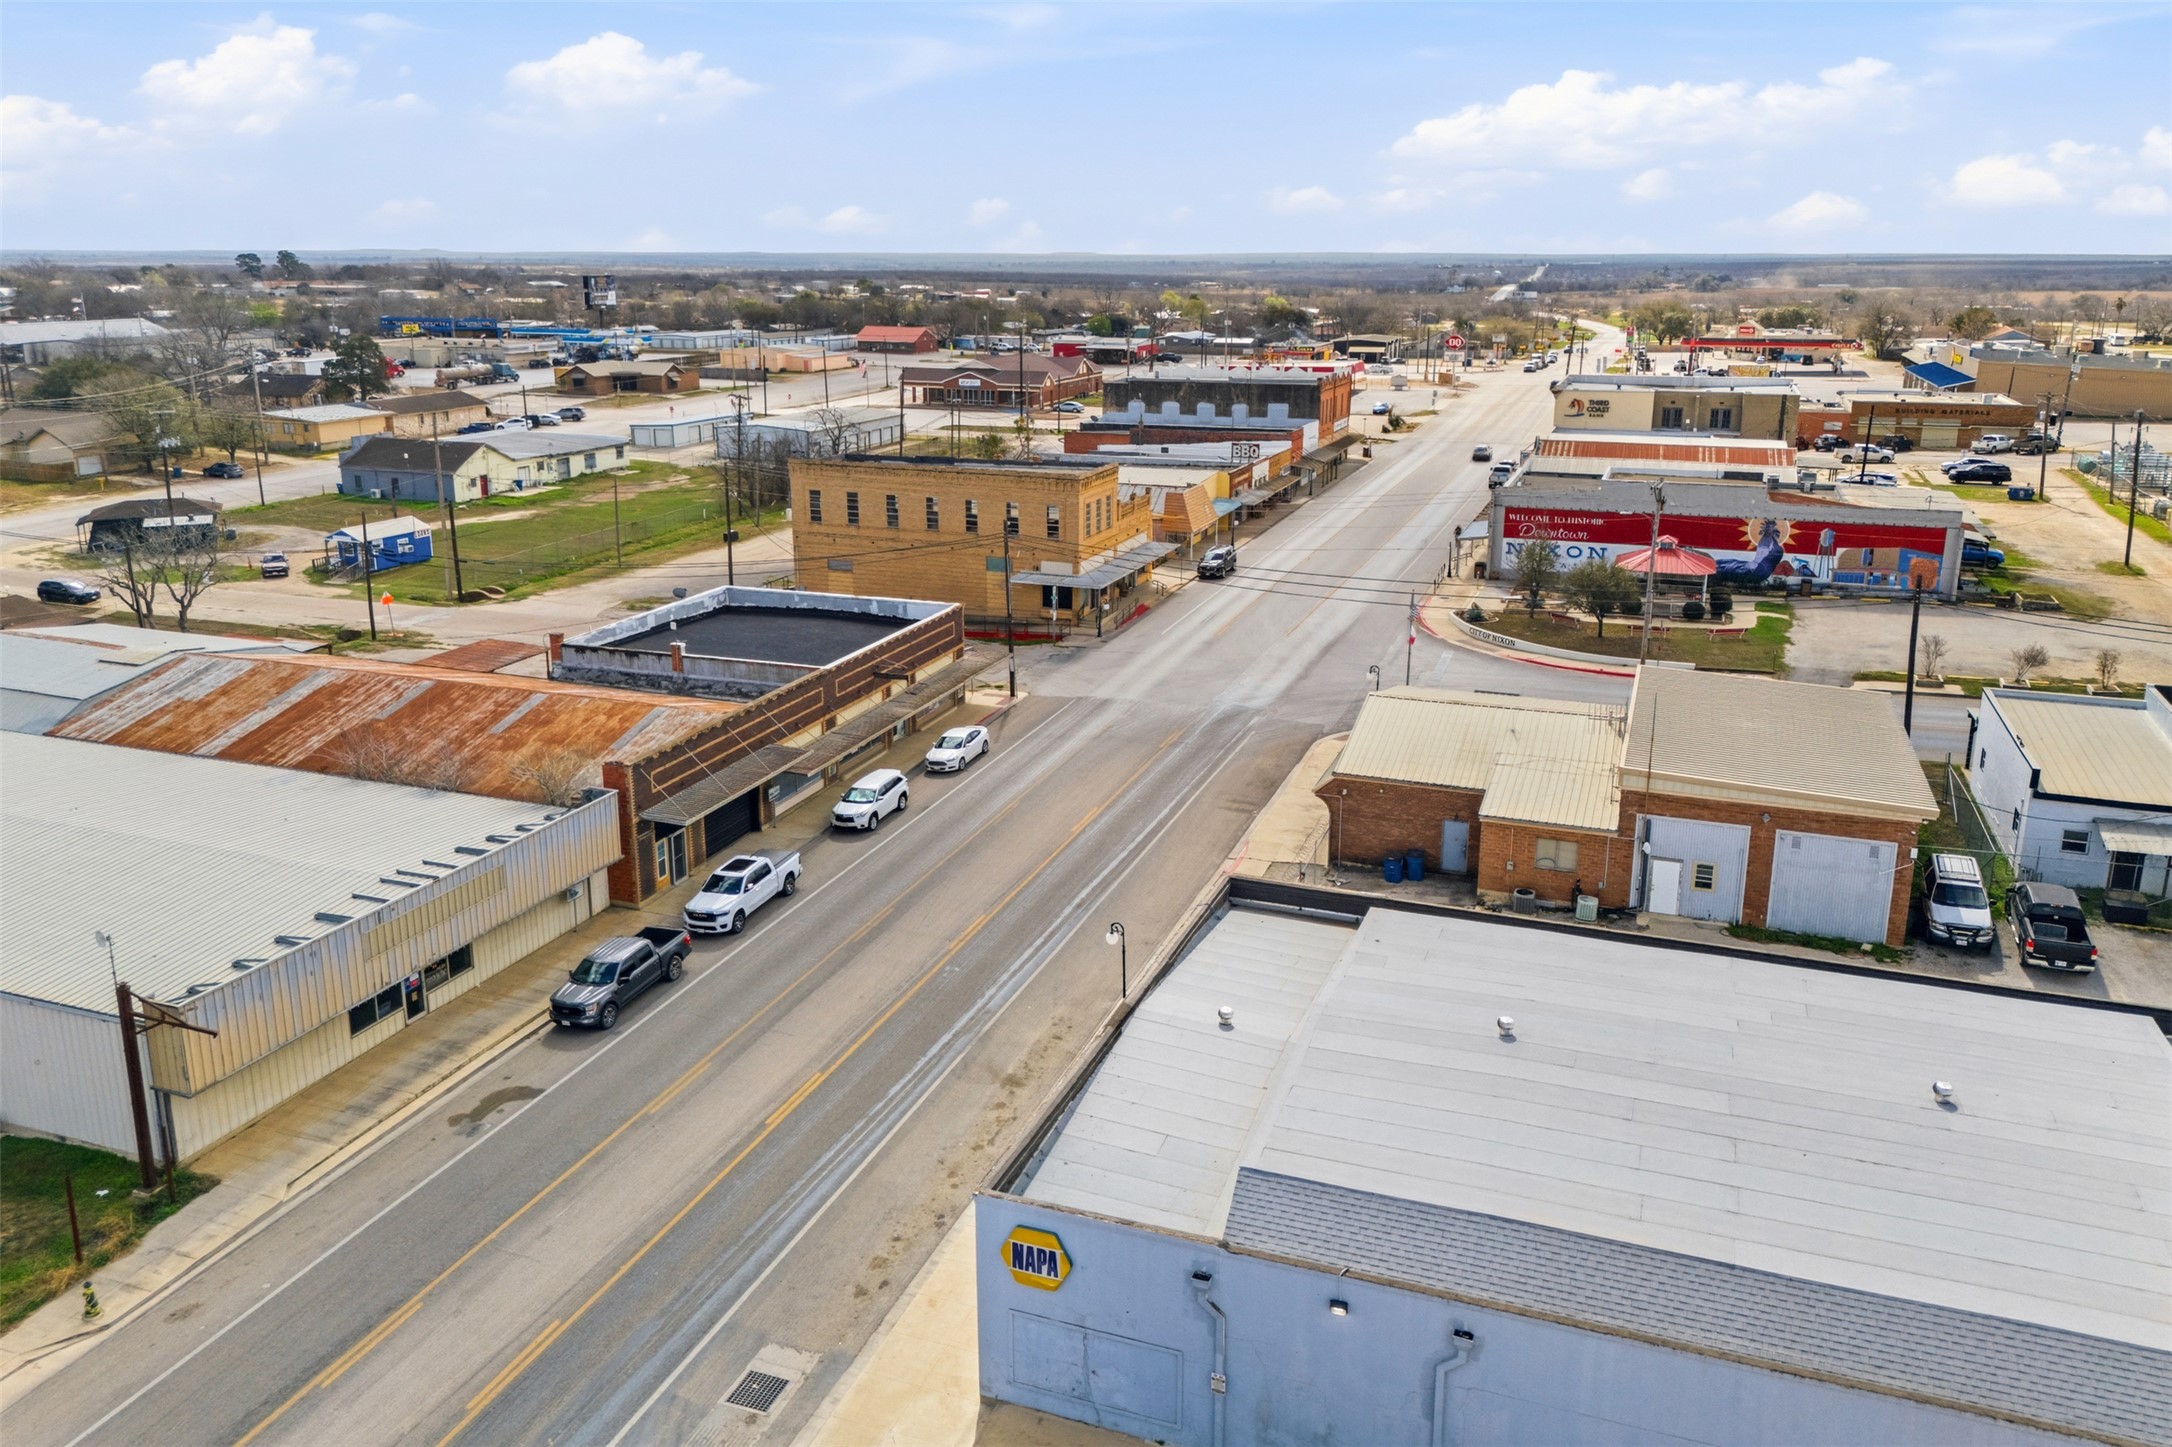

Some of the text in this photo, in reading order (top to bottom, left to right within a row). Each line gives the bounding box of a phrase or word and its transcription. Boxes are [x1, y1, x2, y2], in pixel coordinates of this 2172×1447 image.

[1232, 445, 1259, 458] BBQ
[1509, 513, 1550, 522] WELCOME
[1518, 522, 1590, 540] Downtown
[1505, 541, 1608, 560] NXON
[1468, 627, 1516, 647] CITY OF NIXON
[1011, 1241, 1059, 1279] NAPA
